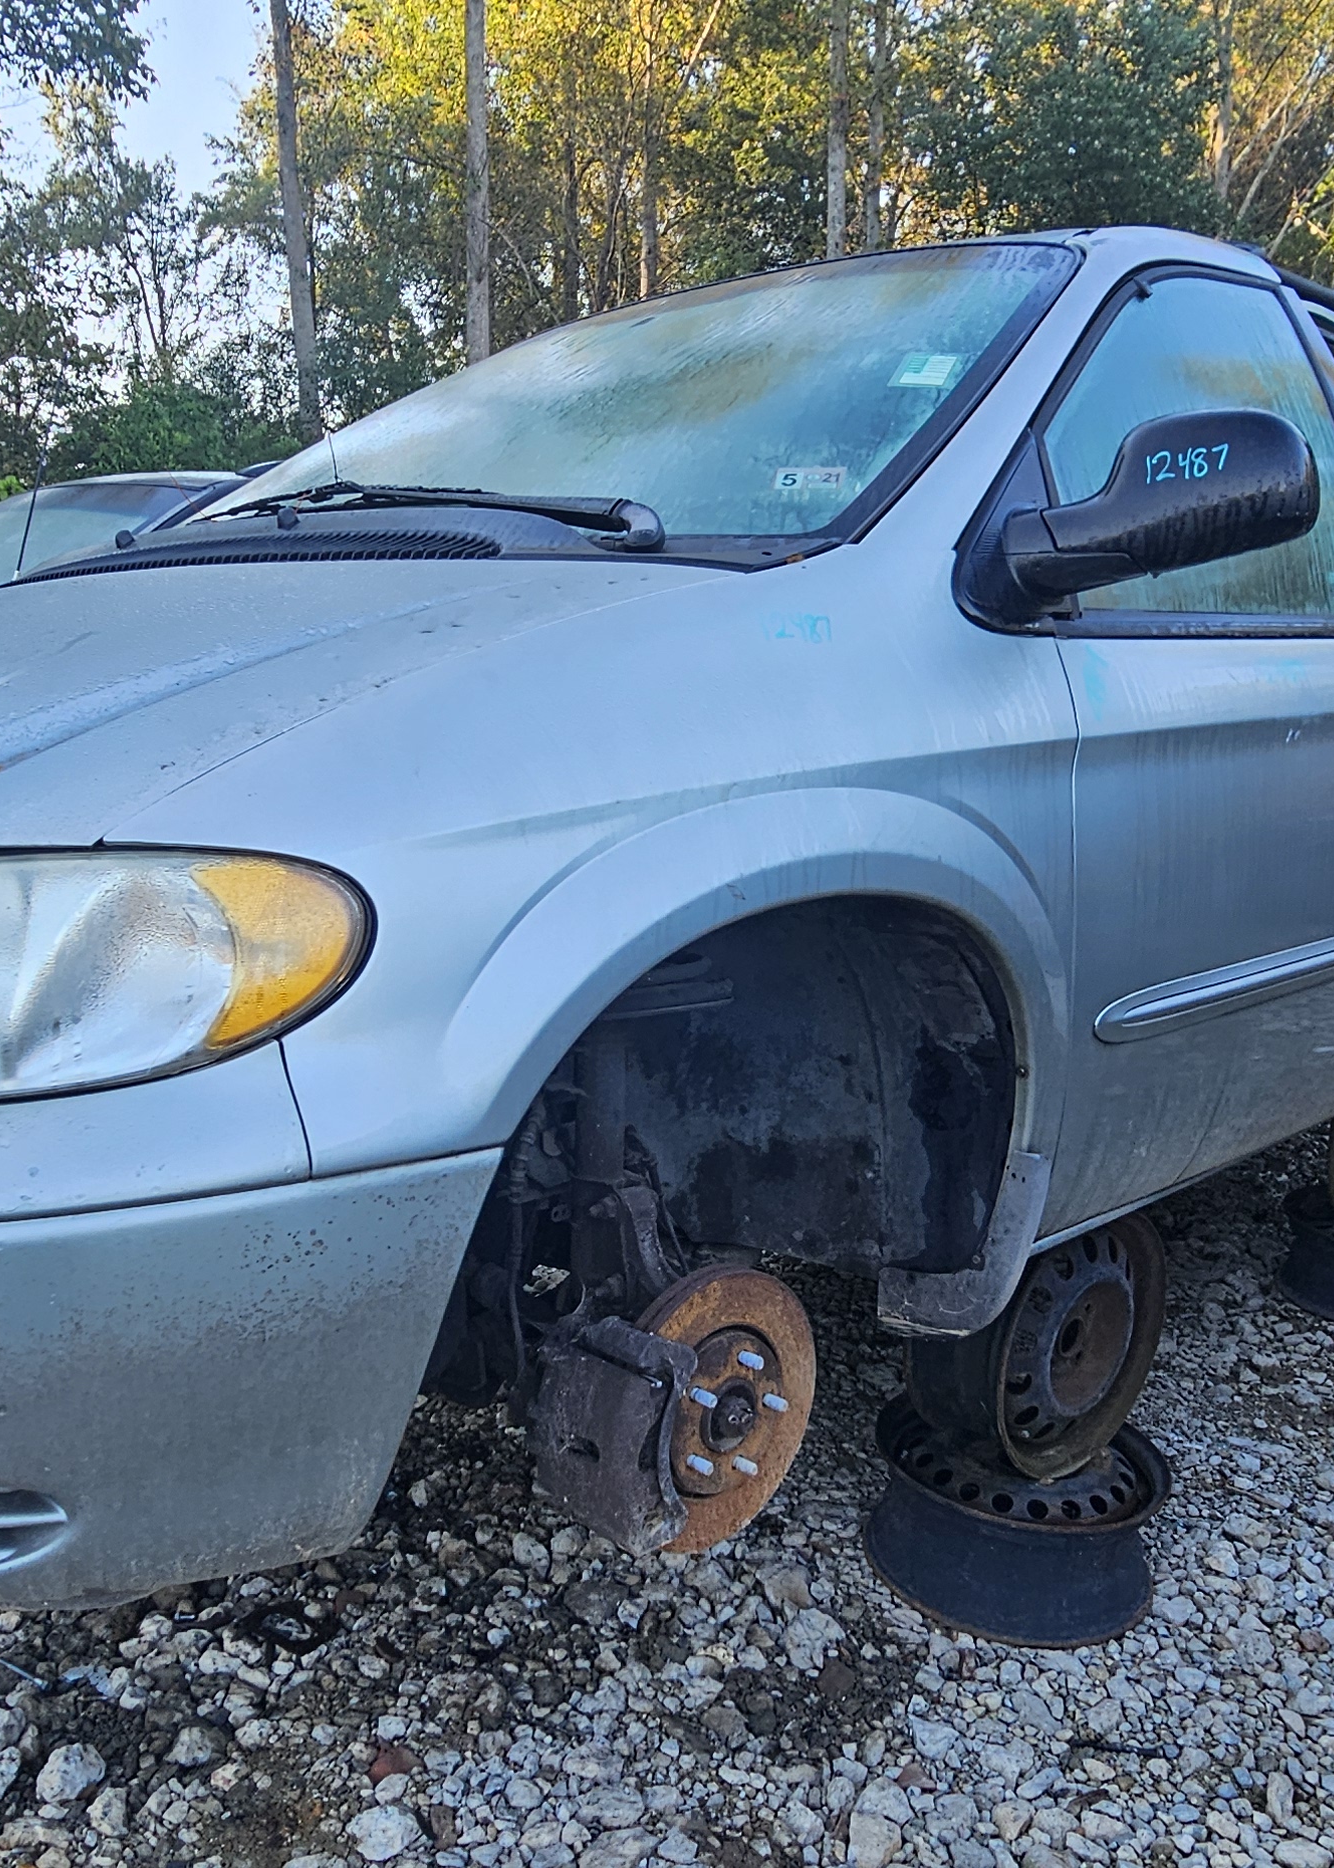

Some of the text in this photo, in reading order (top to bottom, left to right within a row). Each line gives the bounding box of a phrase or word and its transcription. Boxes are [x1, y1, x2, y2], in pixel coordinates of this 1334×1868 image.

[1146, 443, 1229, 484] 12487
[781, 472, 842, 487] 5 21
